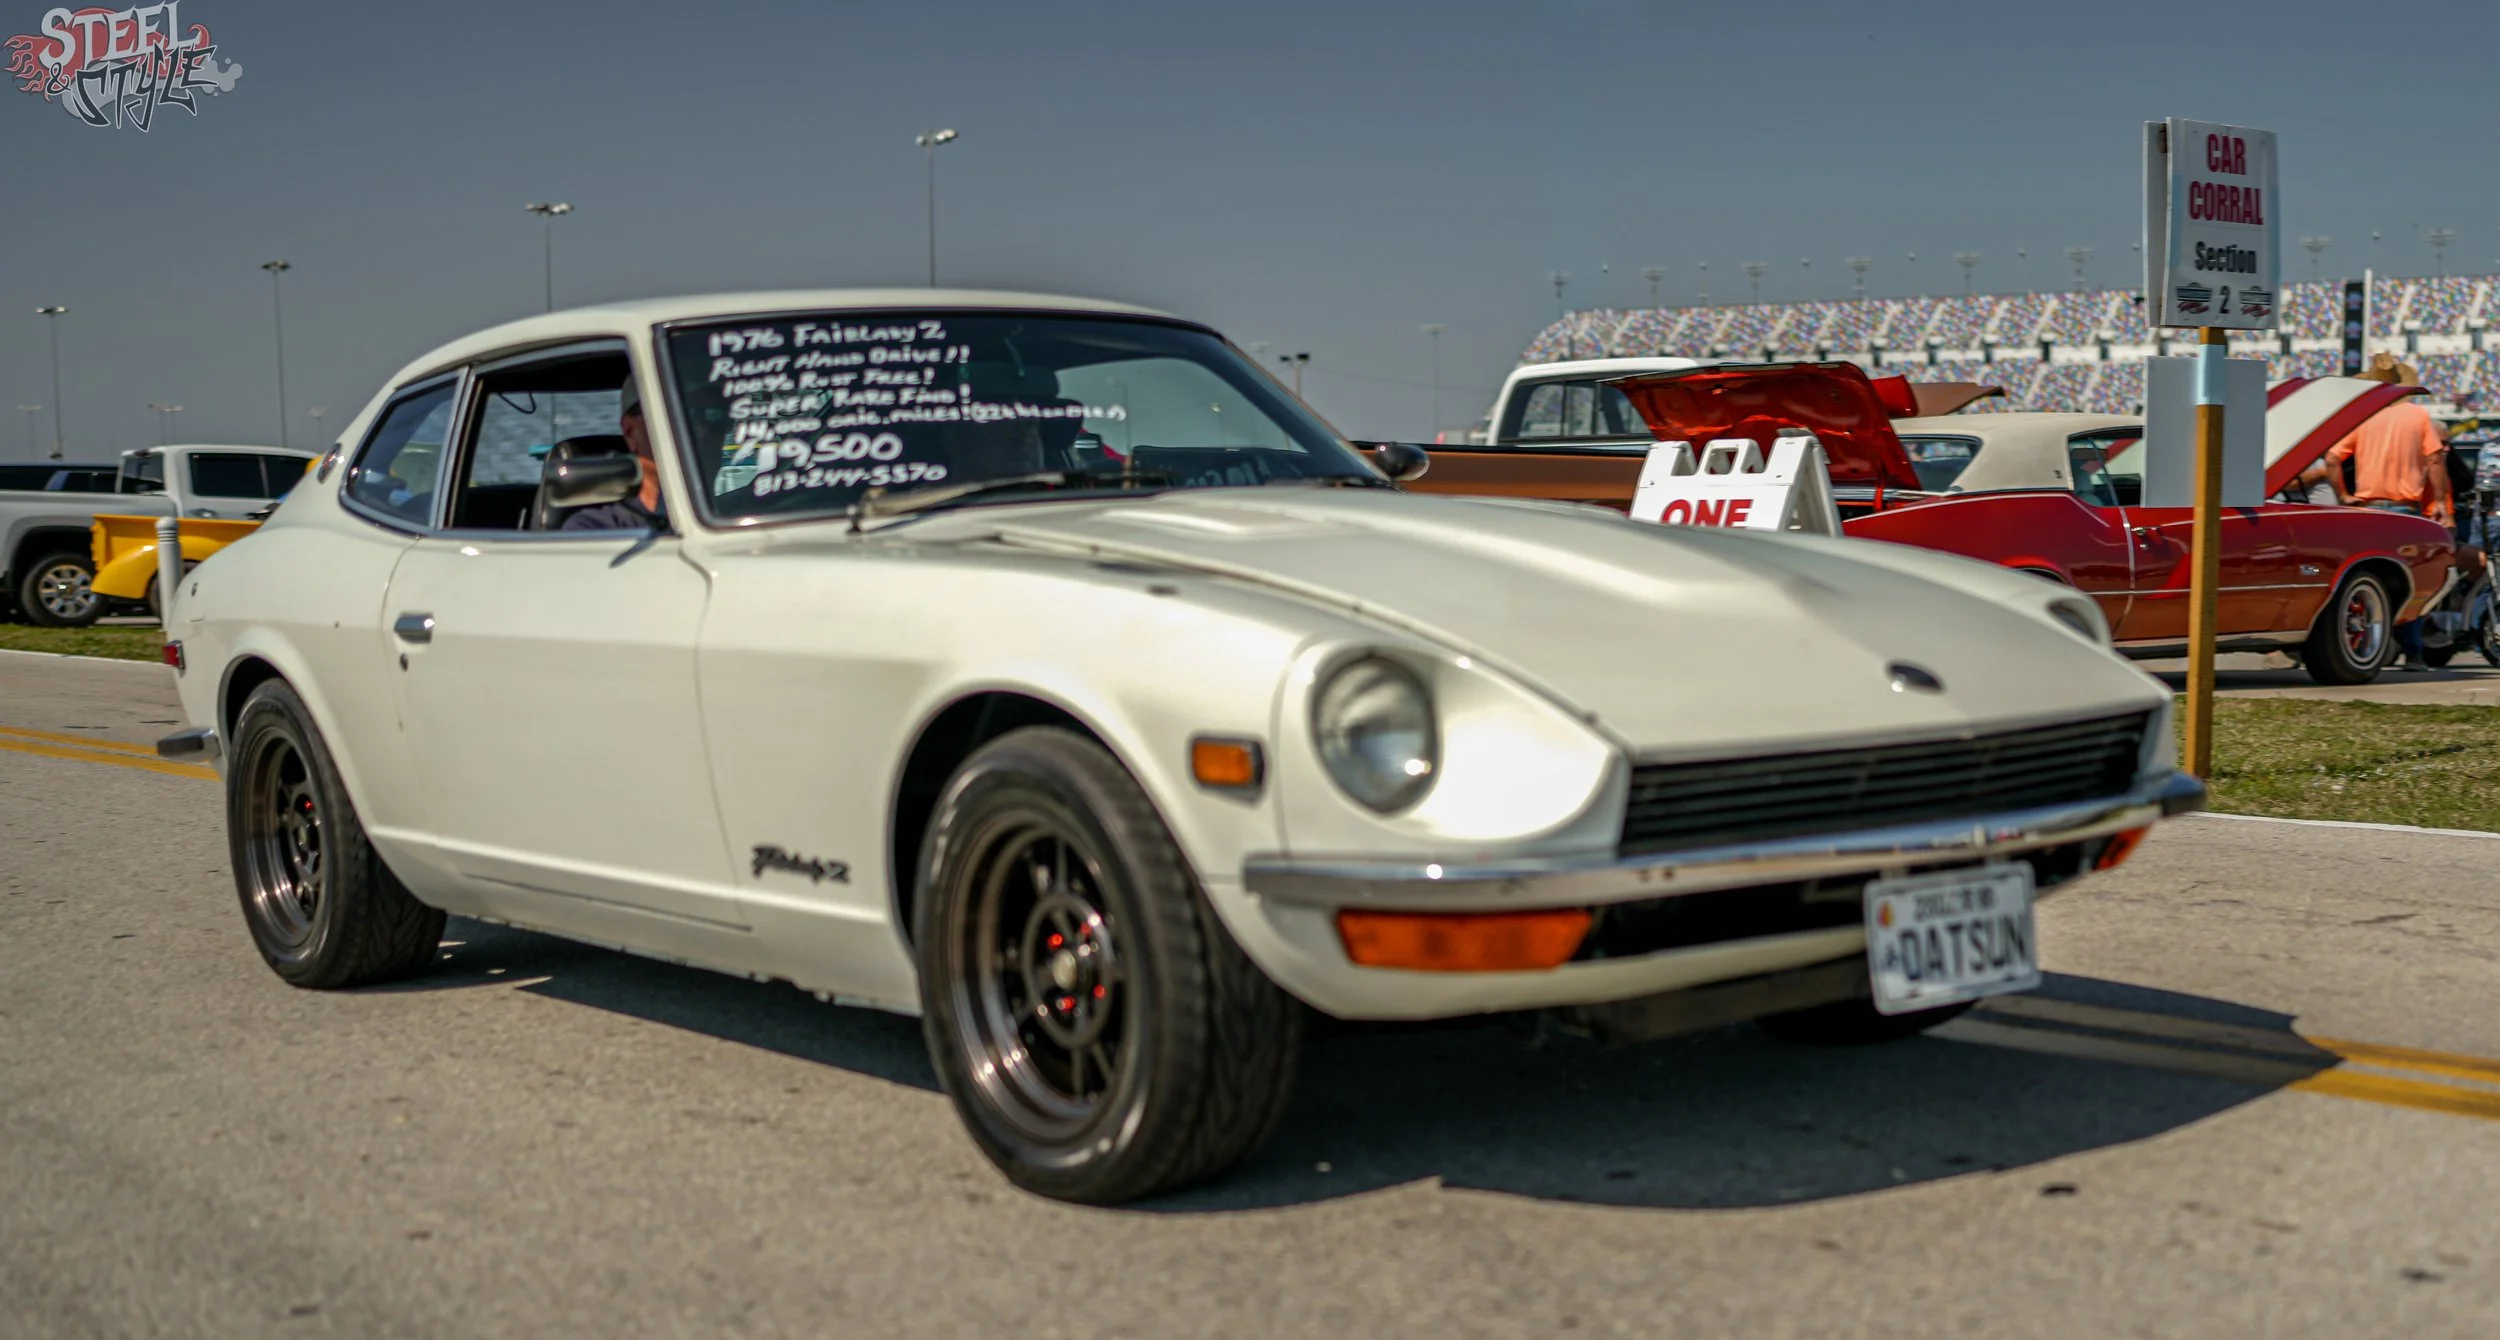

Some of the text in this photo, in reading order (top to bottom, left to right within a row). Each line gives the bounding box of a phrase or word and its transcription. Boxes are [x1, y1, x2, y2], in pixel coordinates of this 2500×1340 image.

[2206, 133, 2247, 176] CAR
[2189, 180, 2264, 226] CORRAL
[2195, 240, 2257, 275] Section
[2218, 285, 2230, 315] 2
[709, 327, 784, 356] 1976
[918, 320, 946, 340] Z
[723, 372, 795, 398] 100%
[735, 416, 822, 443] 14,000
[1659, 499, 1755, 529] ONE
[1899, 915, 2028, 983] DATSUN
